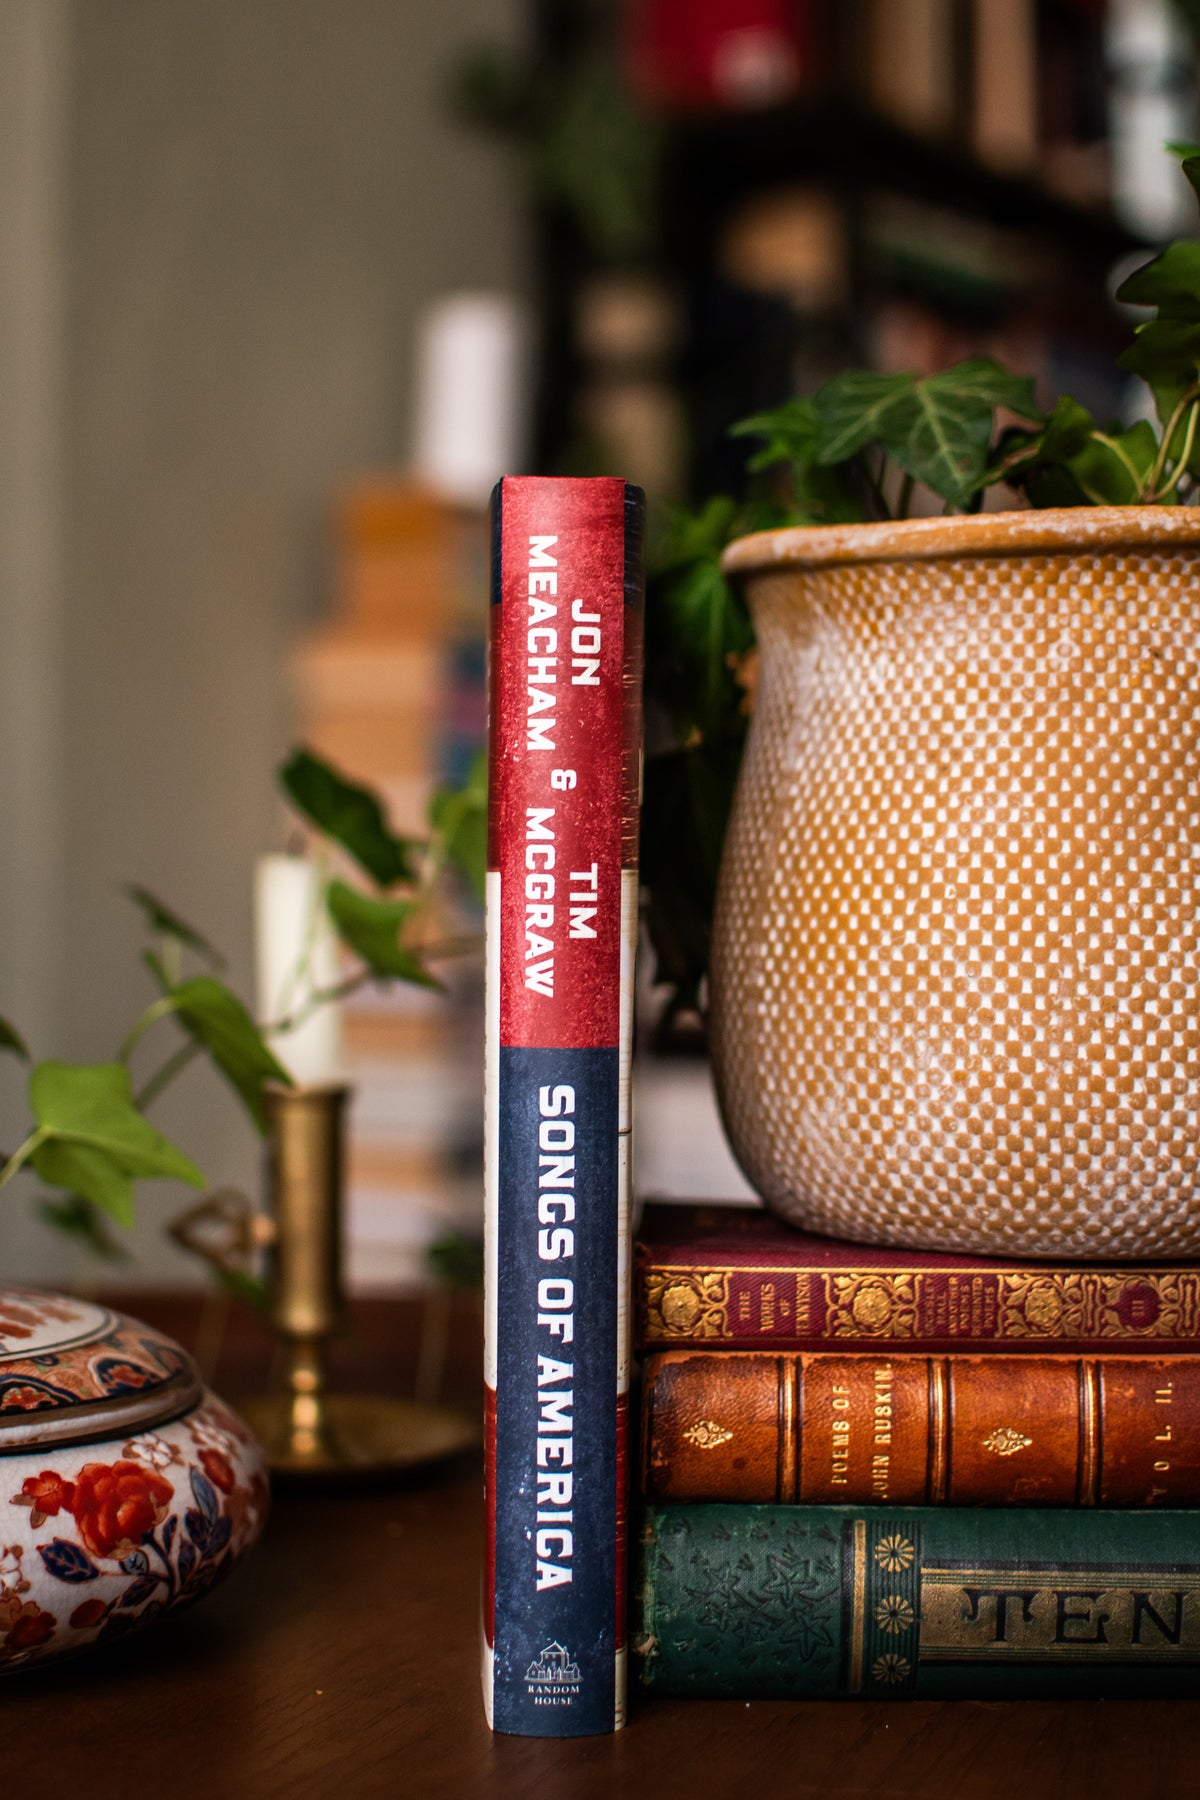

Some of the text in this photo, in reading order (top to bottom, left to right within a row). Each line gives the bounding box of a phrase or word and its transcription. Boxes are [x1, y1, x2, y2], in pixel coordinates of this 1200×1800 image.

[524, 534, 560, 753] MEACHAM
[570, 598, 601, 687] JON
[550, 768, 577, 793] &
[519, 806, 556, 998] MCGRAW
[567, 862, 599, 940] TIM
[535, 1084, 576, 1592] SONGS OF AMERICA
[739, 1291, 751, 1321] THE
[759, 1282, 775, 1331] WORKS
[779, 1297, 791, 1318] OF
[831, 1385, 850, 1484] POEMS OF
[874, 1363, 892, 1444] RUSKIN.
[527, 1684, 580, 1694] RANDOM
[534, 1696, 573, 1706] HOUSE
